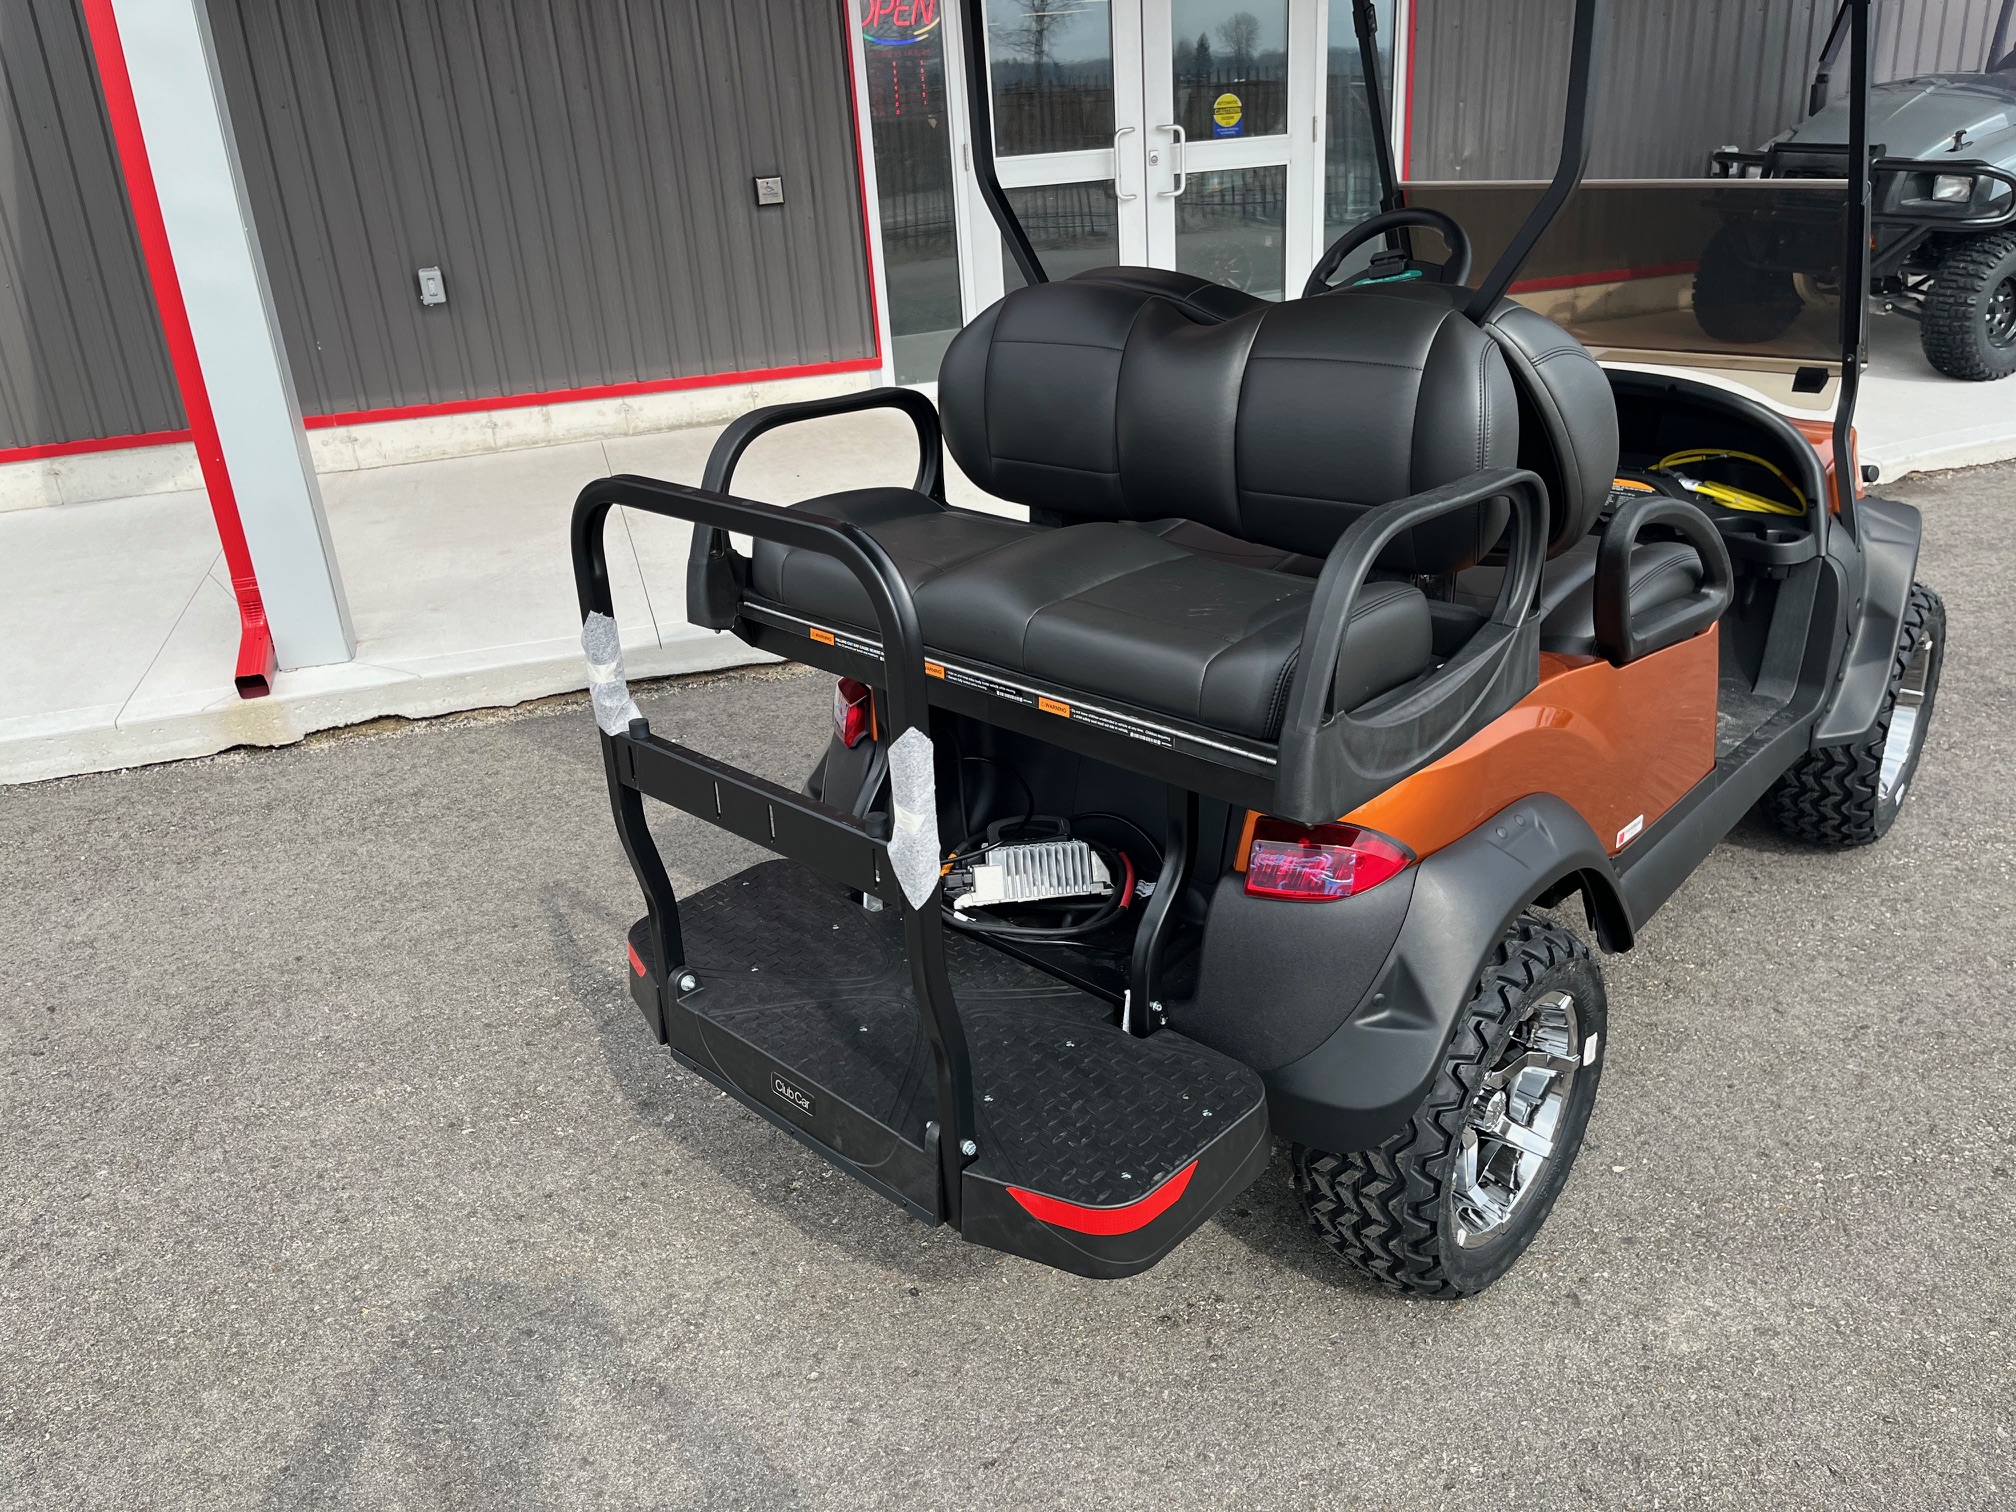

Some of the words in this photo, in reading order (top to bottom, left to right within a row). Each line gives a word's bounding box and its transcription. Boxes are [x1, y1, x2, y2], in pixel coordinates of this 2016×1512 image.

[926, 665, 942, 675] ARNING
[1045, 702, 1067, 714] WARNING
[775, 1079, 794, 1100] Club
[794, 1091, 810, 1110] Car
